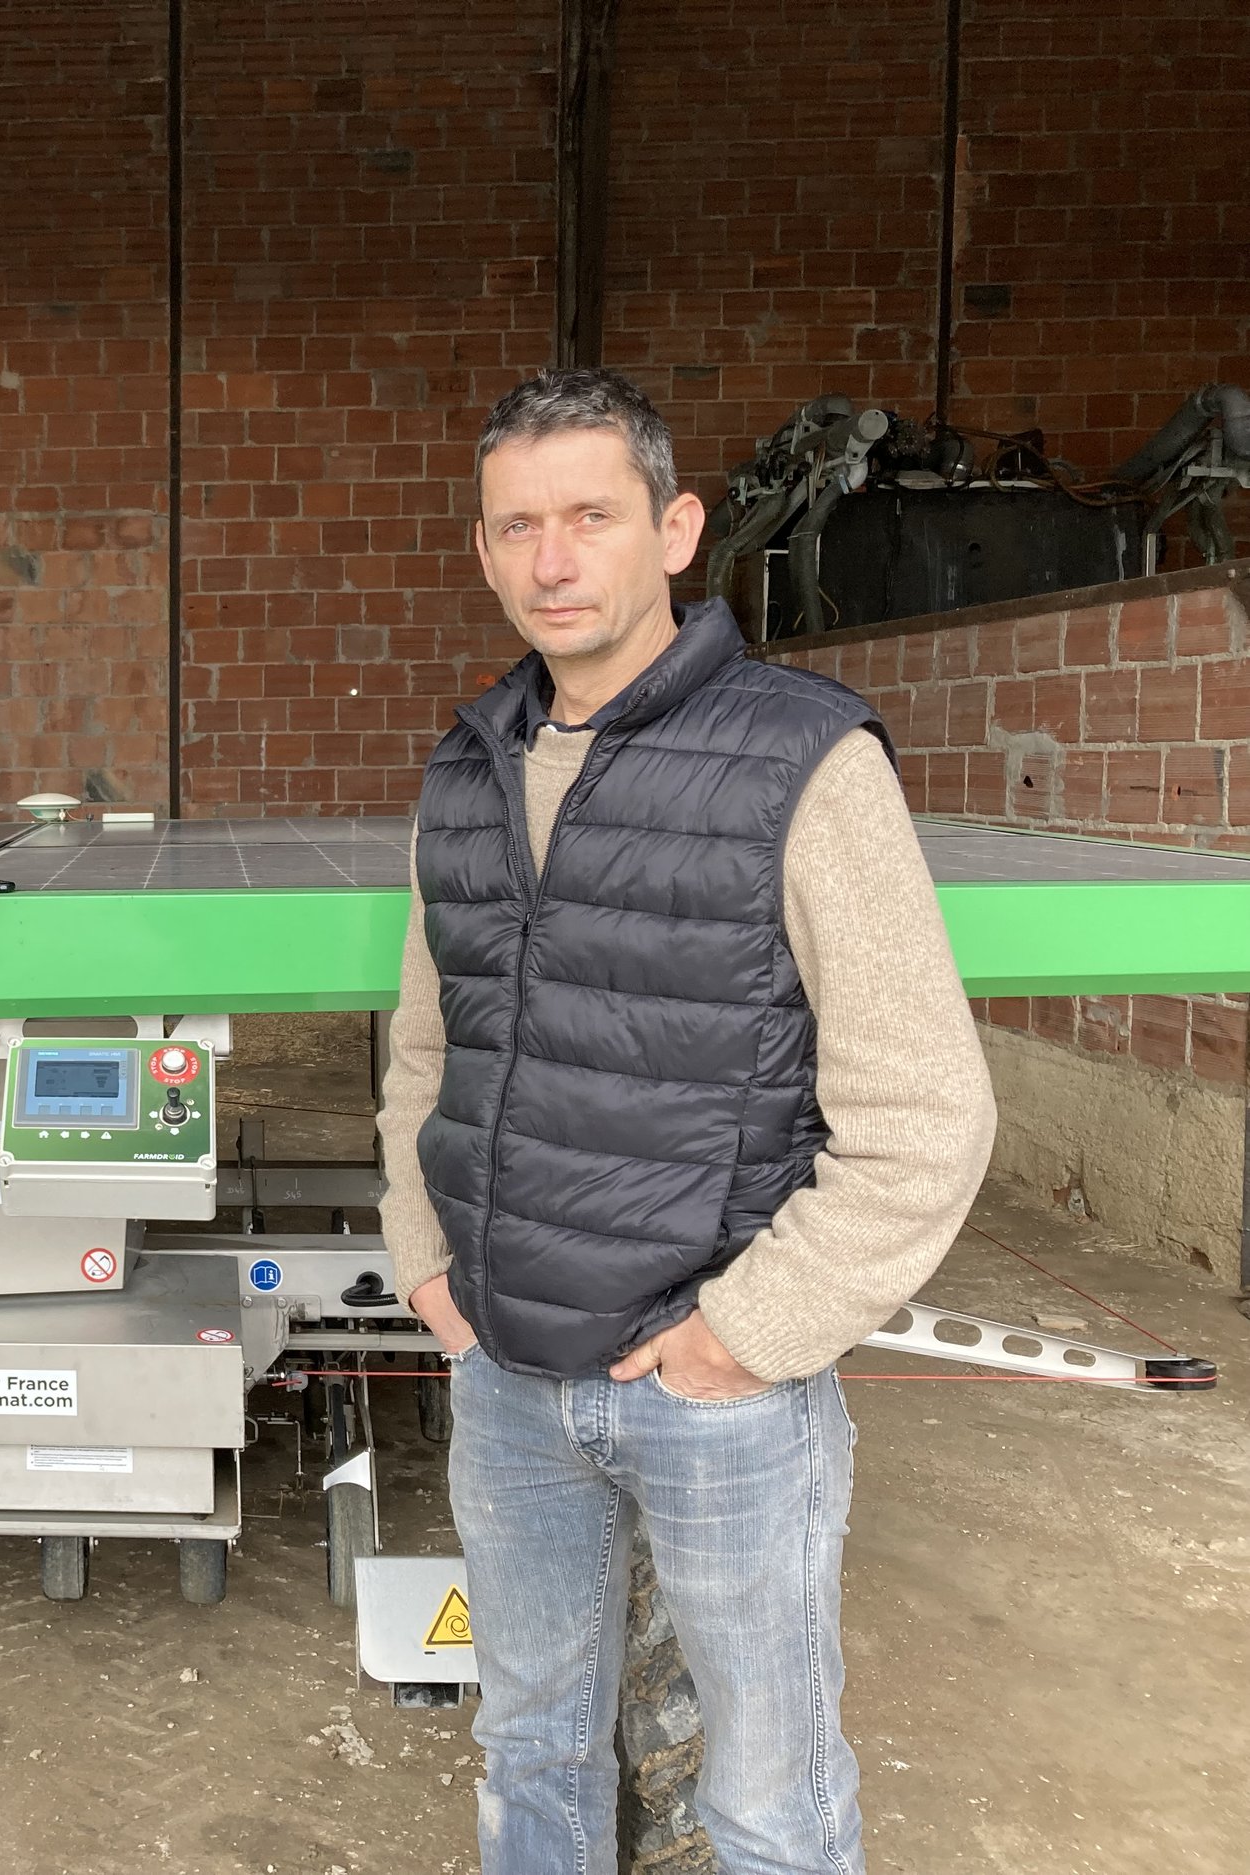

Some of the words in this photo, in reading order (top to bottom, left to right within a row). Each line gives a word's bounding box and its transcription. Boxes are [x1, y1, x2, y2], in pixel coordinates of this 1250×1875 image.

[150, 1056, 158, 1074] STOP
[190, 1056, 198, 1075] STOP
[7, 1376, 69, 1391] France
